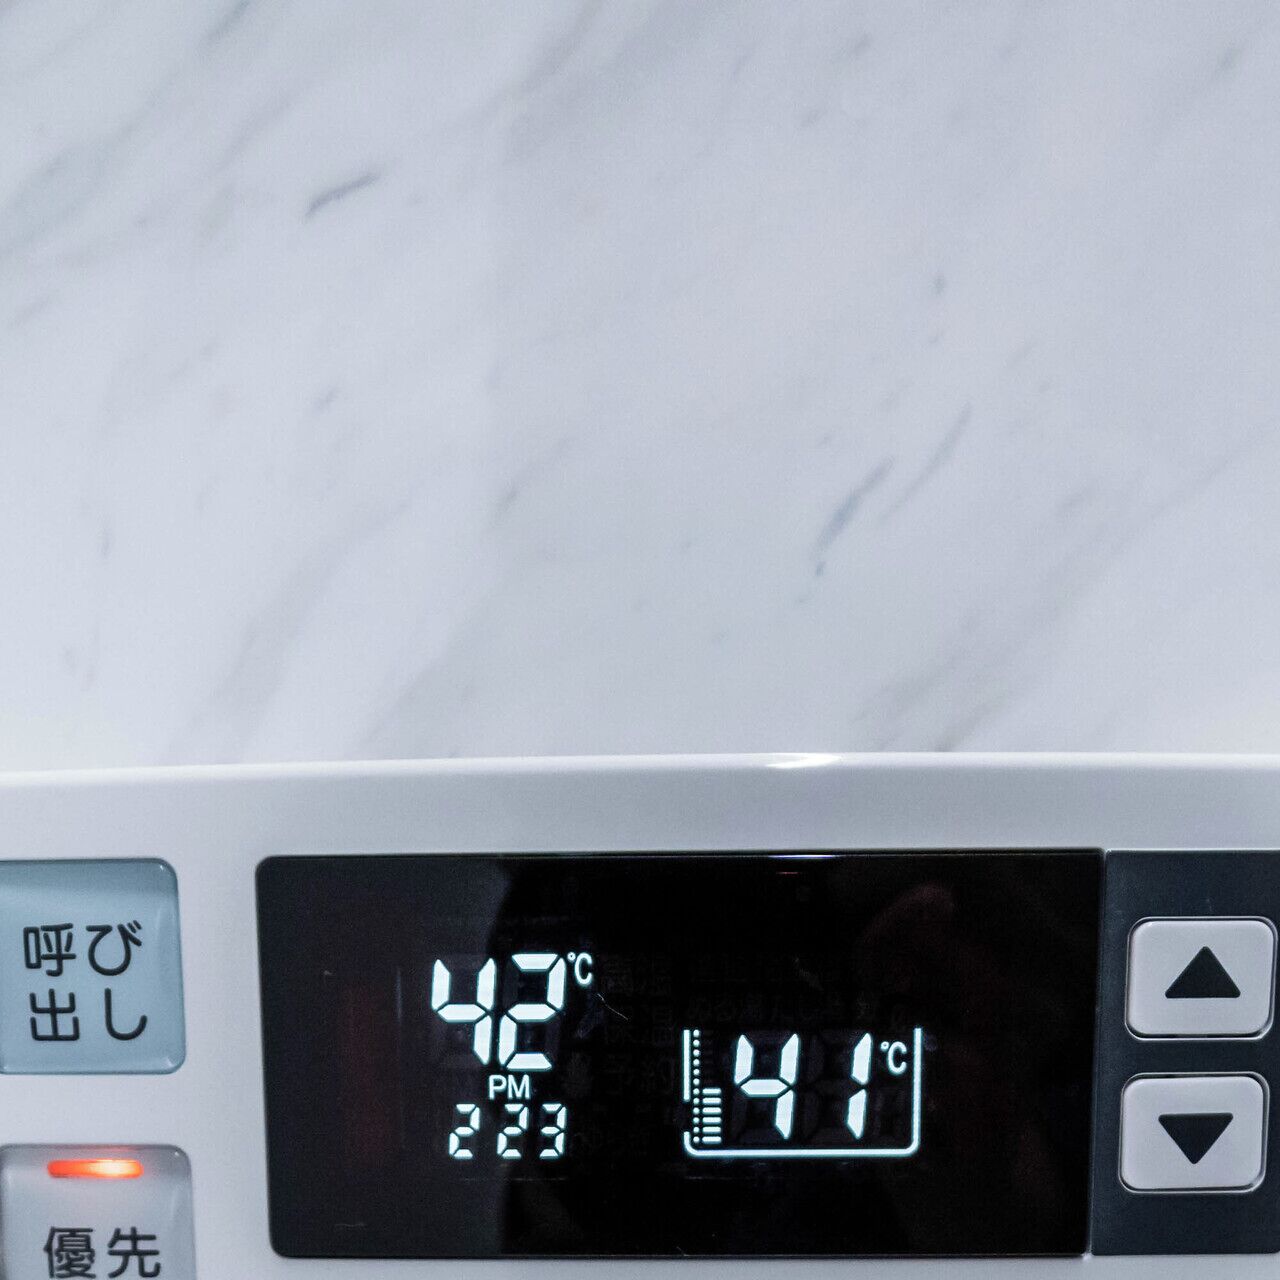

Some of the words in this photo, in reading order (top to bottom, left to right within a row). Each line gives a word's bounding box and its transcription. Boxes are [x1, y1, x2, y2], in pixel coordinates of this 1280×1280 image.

[23, 920, 143, 978] 呼び
[29, 987, 149, 1042] 出し
[488, 1074, 530, 1100] PM
[42, 1225, 162, 1280] 優先
